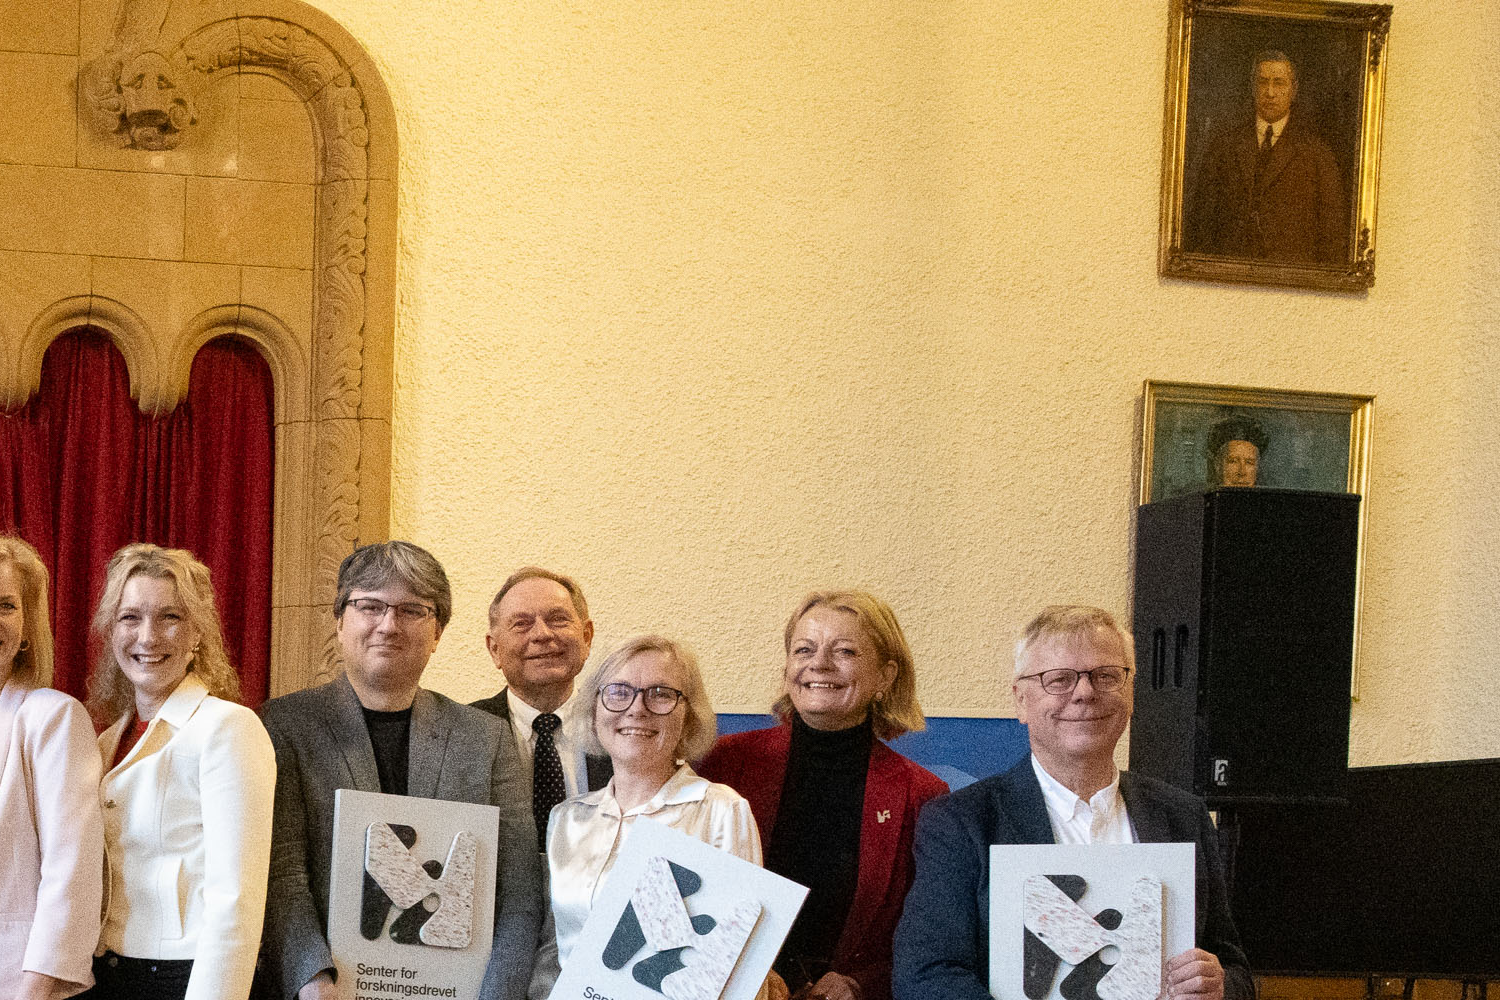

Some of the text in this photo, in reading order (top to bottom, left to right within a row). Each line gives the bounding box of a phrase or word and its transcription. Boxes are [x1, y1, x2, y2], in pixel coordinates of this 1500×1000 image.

[357, 963, 418, 980] Senter for
[356, 978, 457, 998] forskningsdrevet
